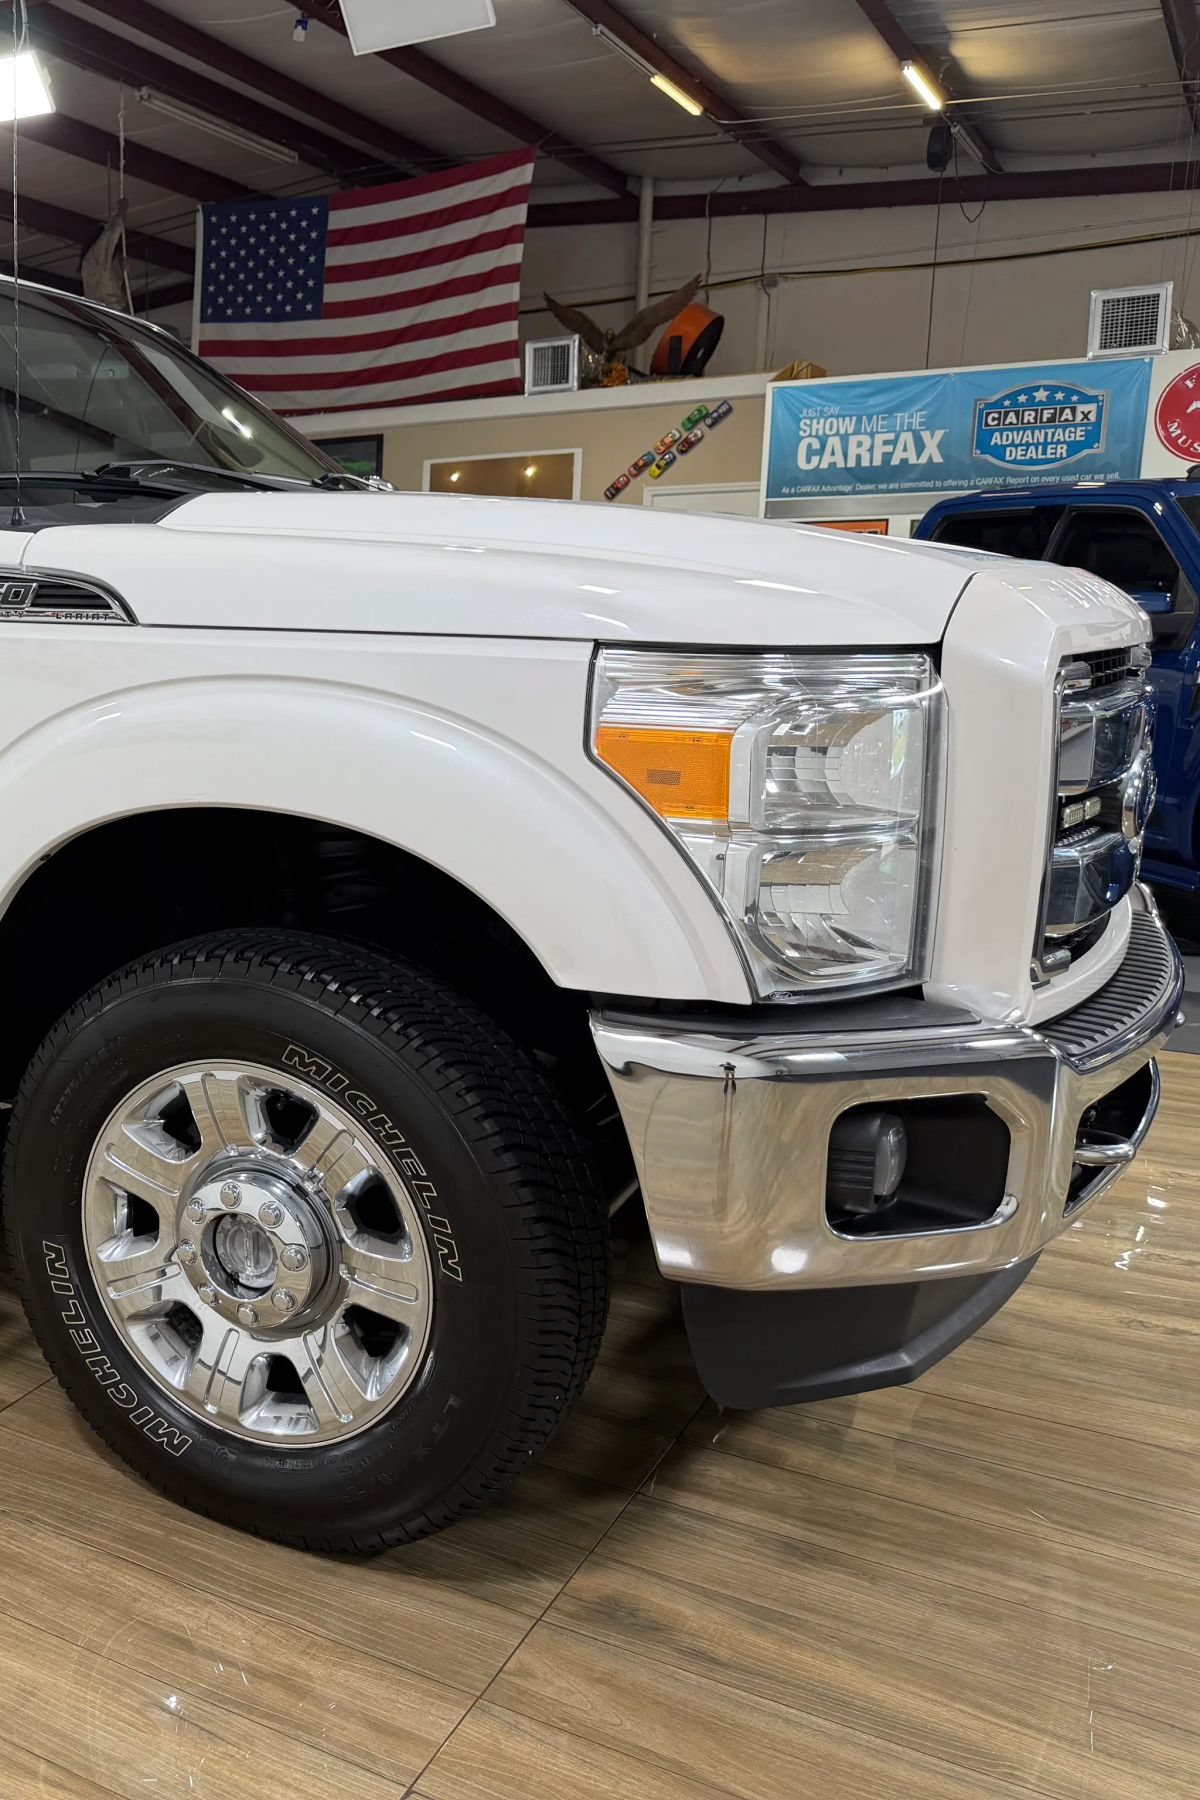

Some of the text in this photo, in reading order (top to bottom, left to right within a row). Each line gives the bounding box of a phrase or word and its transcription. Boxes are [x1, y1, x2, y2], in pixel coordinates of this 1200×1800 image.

[799, 406, 841, 418] JUST SAY
[986, 406, 1094, 427] CARFAX
[799, 411, 928, 437] SHOW ME THE
[990, 427, 1086, 446] ADVANTAGE
[796, 429, 946, 471] CARFAX
[1005, 444, 1068, 461] DEALER
[900, 481, 934, 489] committed
[943, 479, 968, 489] offering
[1006, 475, 1029, 485] Report
[1041, 476, 1060, 485] every
[1061, 473, 1079, 482] used
[55, 613, 110, 622] LARIAT
[282, 1045, 463, 1282] MICHELIN
[43, 1240, 193, 1457] MICHELIN
